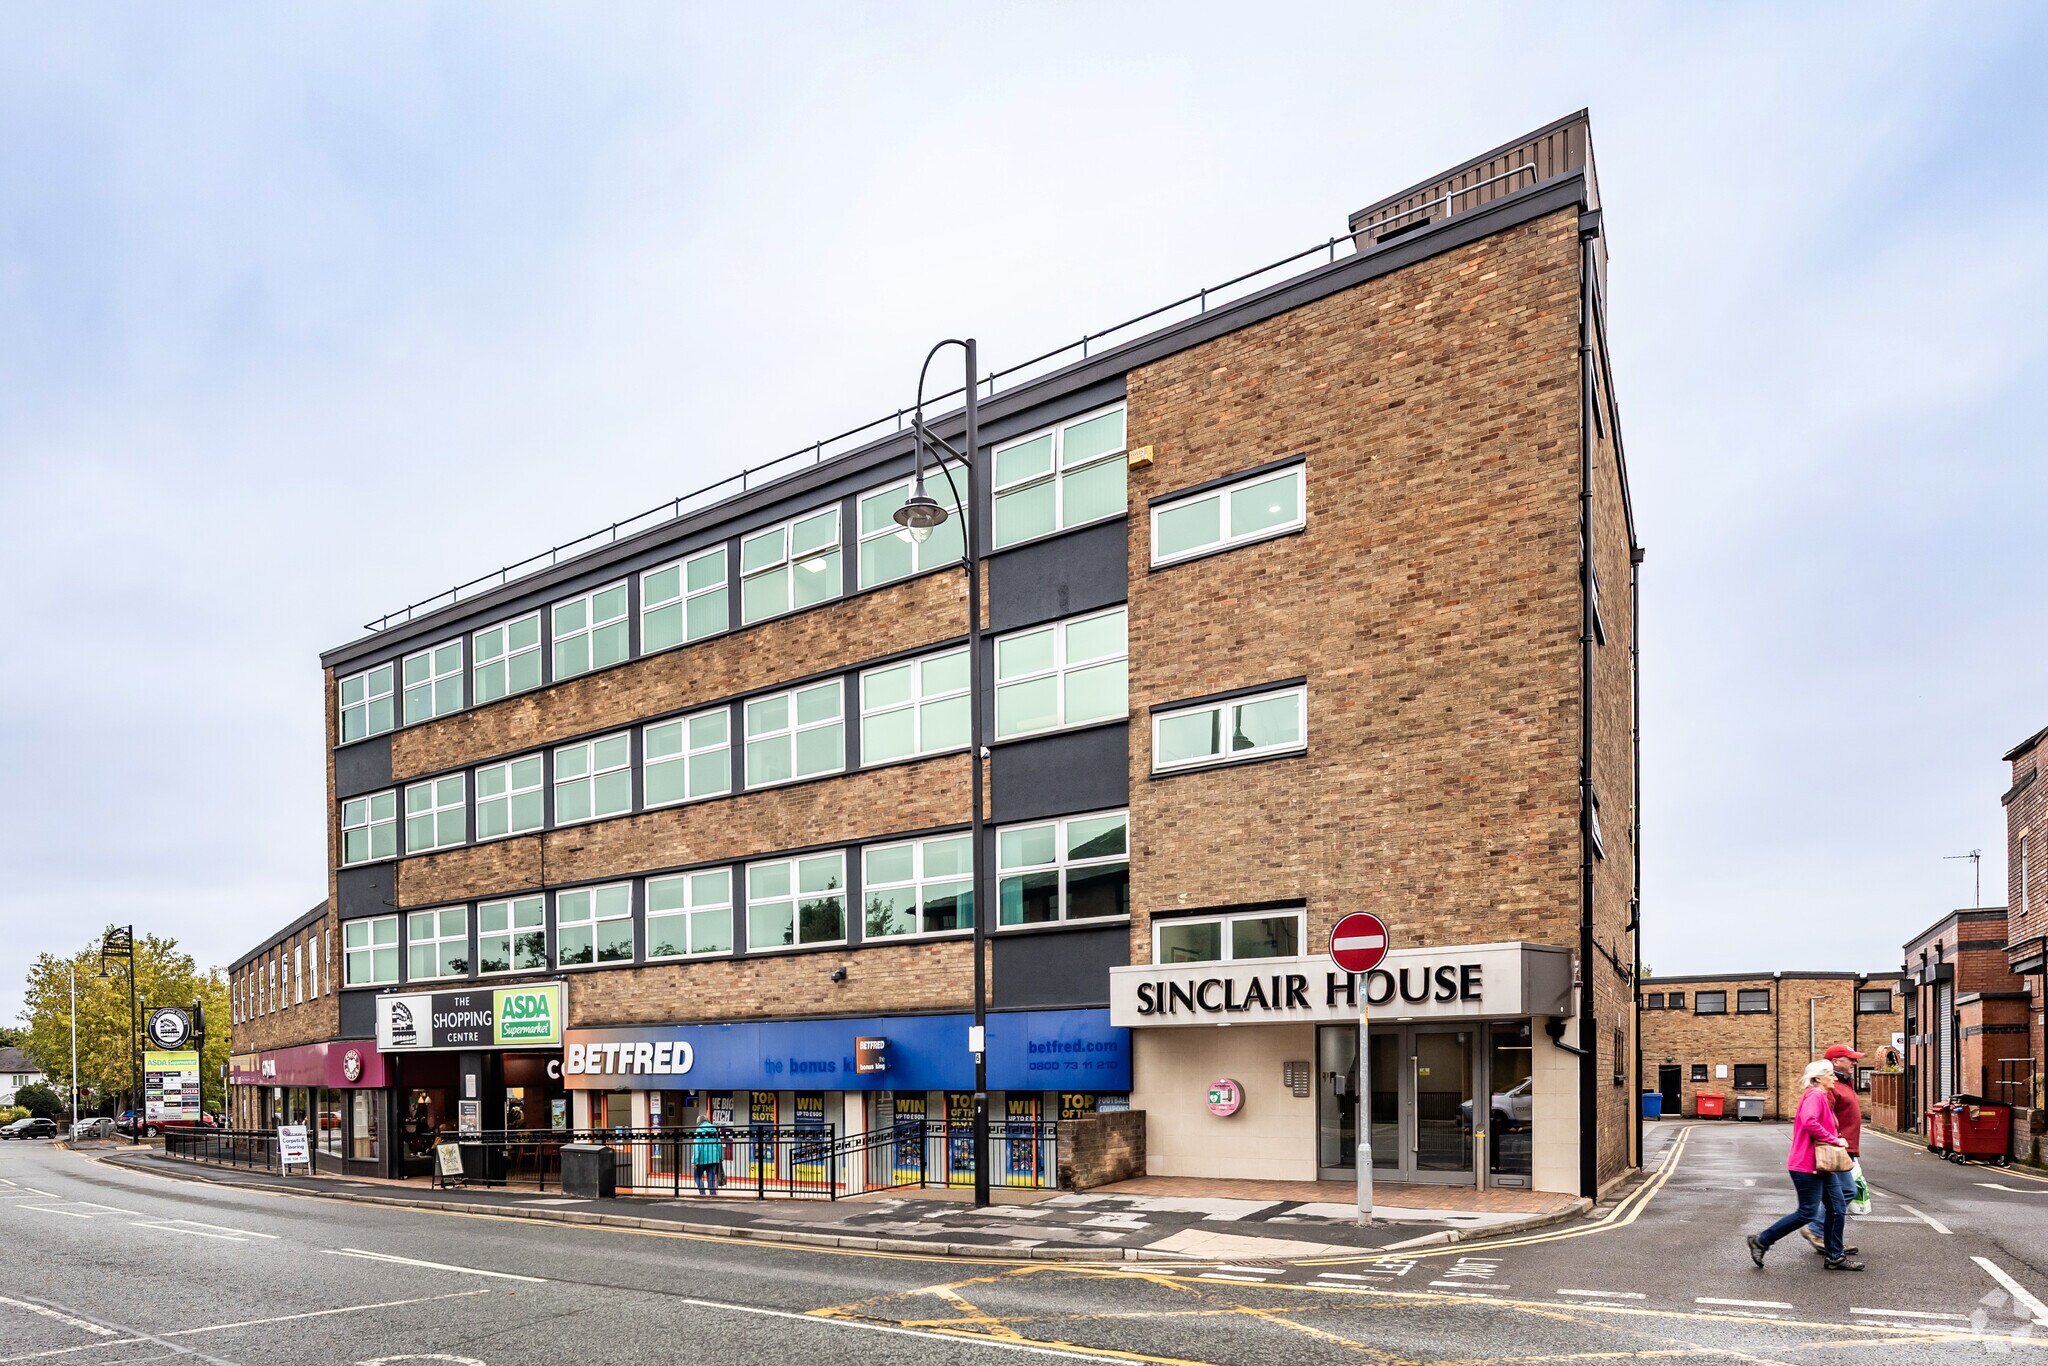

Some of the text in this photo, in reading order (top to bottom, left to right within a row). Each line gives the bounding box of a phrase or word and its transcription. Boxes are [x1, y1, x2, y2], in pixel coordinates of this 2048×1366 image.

[1136, 963, 1483, 1014] SINCLAIR HOUSE
[454, 996, 470, 1007] THE
[501, 994, 550, 1020] ASDA
[433, 1010, 492, 1028] SHOPPING
[502, 1022, 549, 1036] Supermarket
[447, 1032, 479, 1042] CENTRE
[860, 1040, 885, 1050] BETFRED
[1029, 1039, 1118, 1053] betfred.com
[567, 1041, 694, 1075] BETFRED
[764, 1057, 856, 1073] the bonus ki
[875, 1062, 886, 1071] king
[1029, 1061, 1118, 1070] 0800 73 11 210
[712, 1097, 734, 1110] HE BIG
[752, 1092, 774, 1104] TOP
[797, 1098, 822, 1110] WIN
[1061, 1094, 1095, 1109] TOP
[1098, 1096, 1130, 1104] FOOTBALL
[752, 1104, 761, 1112] OF
[896, 1099, 925, 1113] WIN
[713, 1110, 731, 1122] ATCH
[752, 1112, 774, 1121] SLOTS
[951, 1108, 962, 1117] OF
[963, 1108, 975, 1117] TH
[1062, 1109, 1075, 1118] OF
